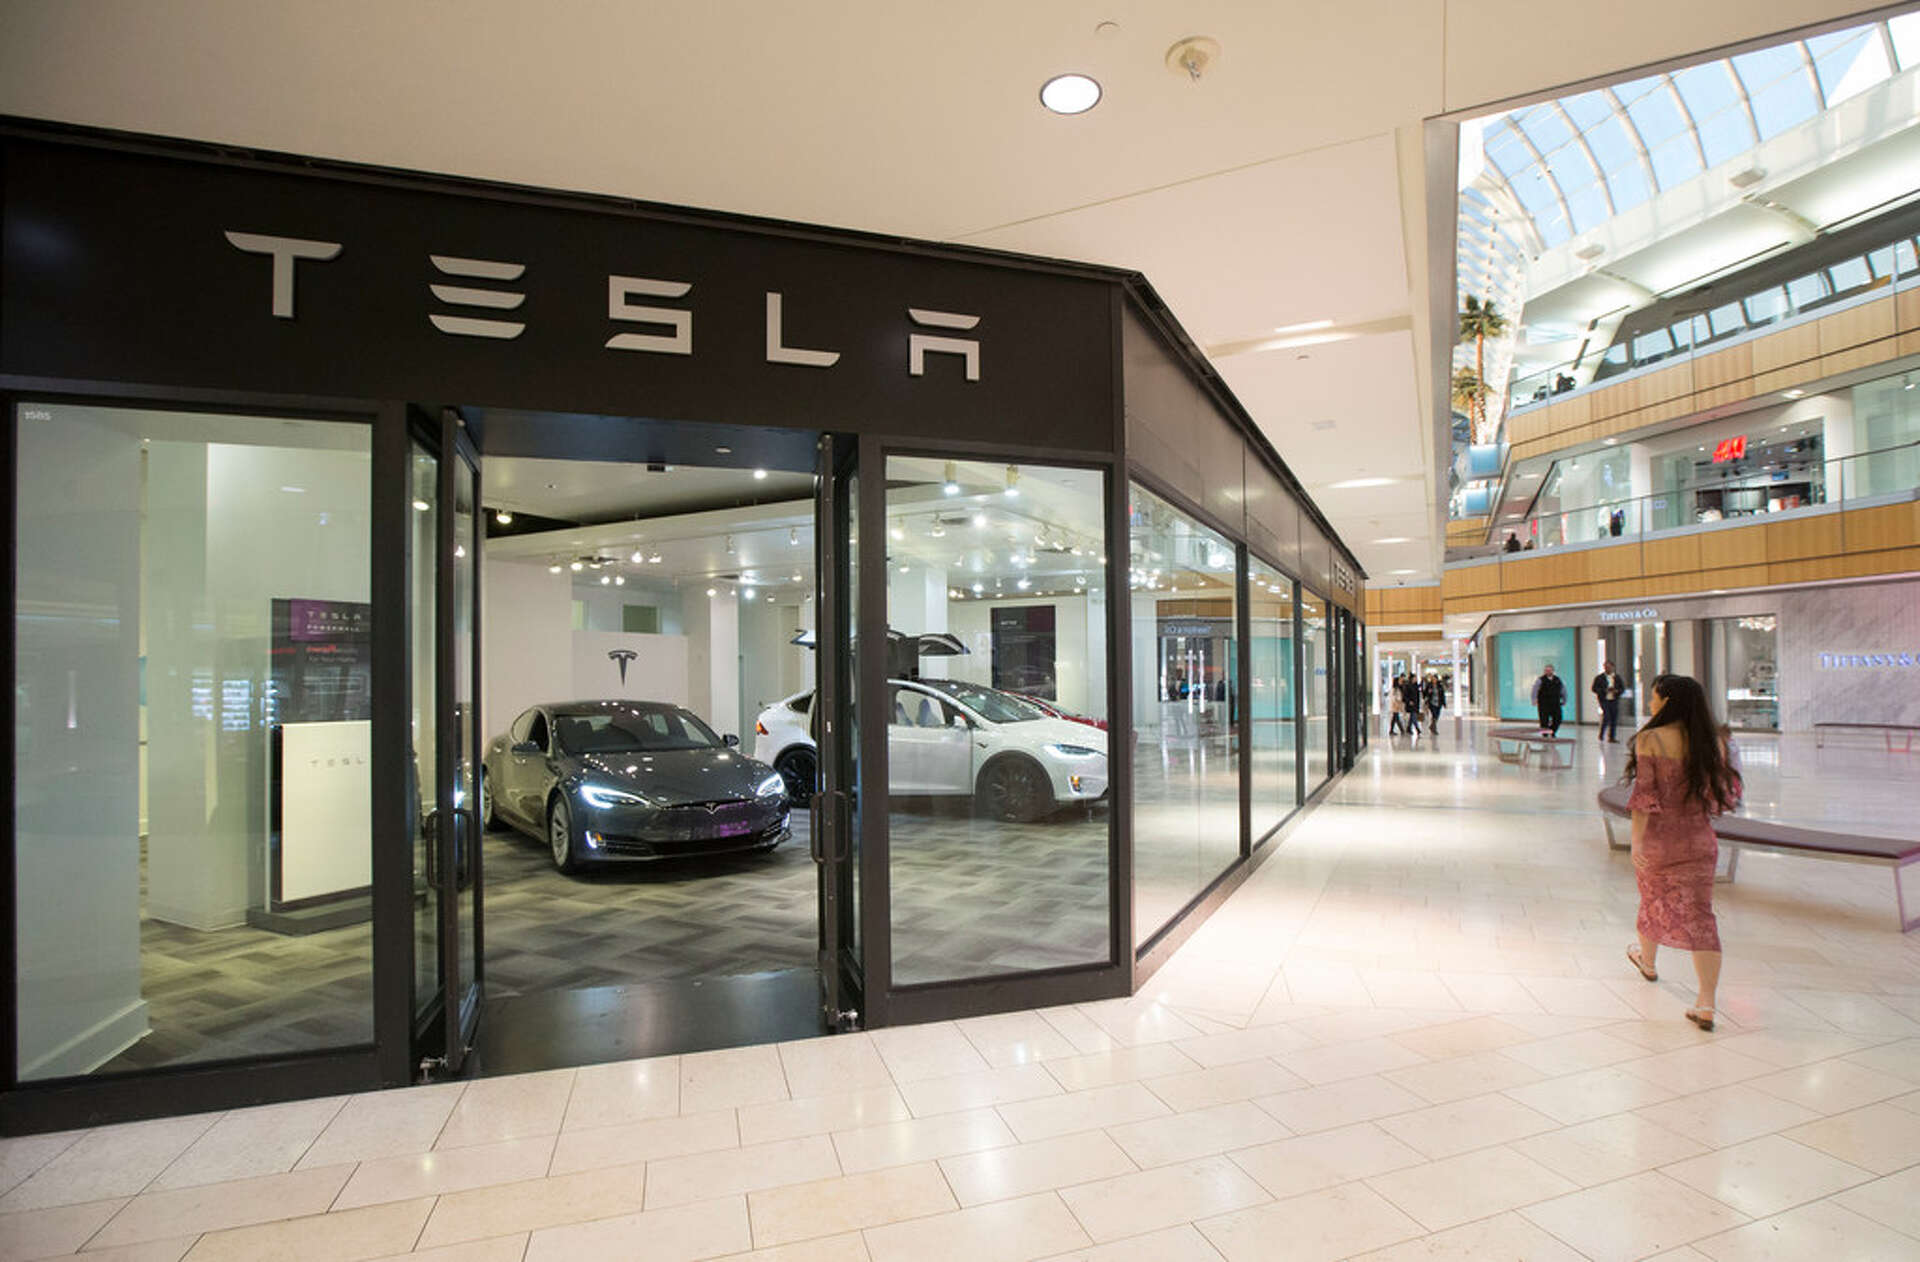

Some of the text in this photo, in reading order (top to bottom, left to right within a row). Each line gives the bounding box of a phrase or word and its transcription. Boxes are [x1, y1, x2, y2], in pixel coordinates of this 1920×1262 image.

[223, 230, 983, 383] TESLA
[306, 610, 362, 622] TESLA
[1600, 610, 1633, 621] TIFFANY
[1818, 651, 1895, 669] TIFFANY
[1897, 651, 1914, 668] &
[309, 757, 368, 768] TESL
